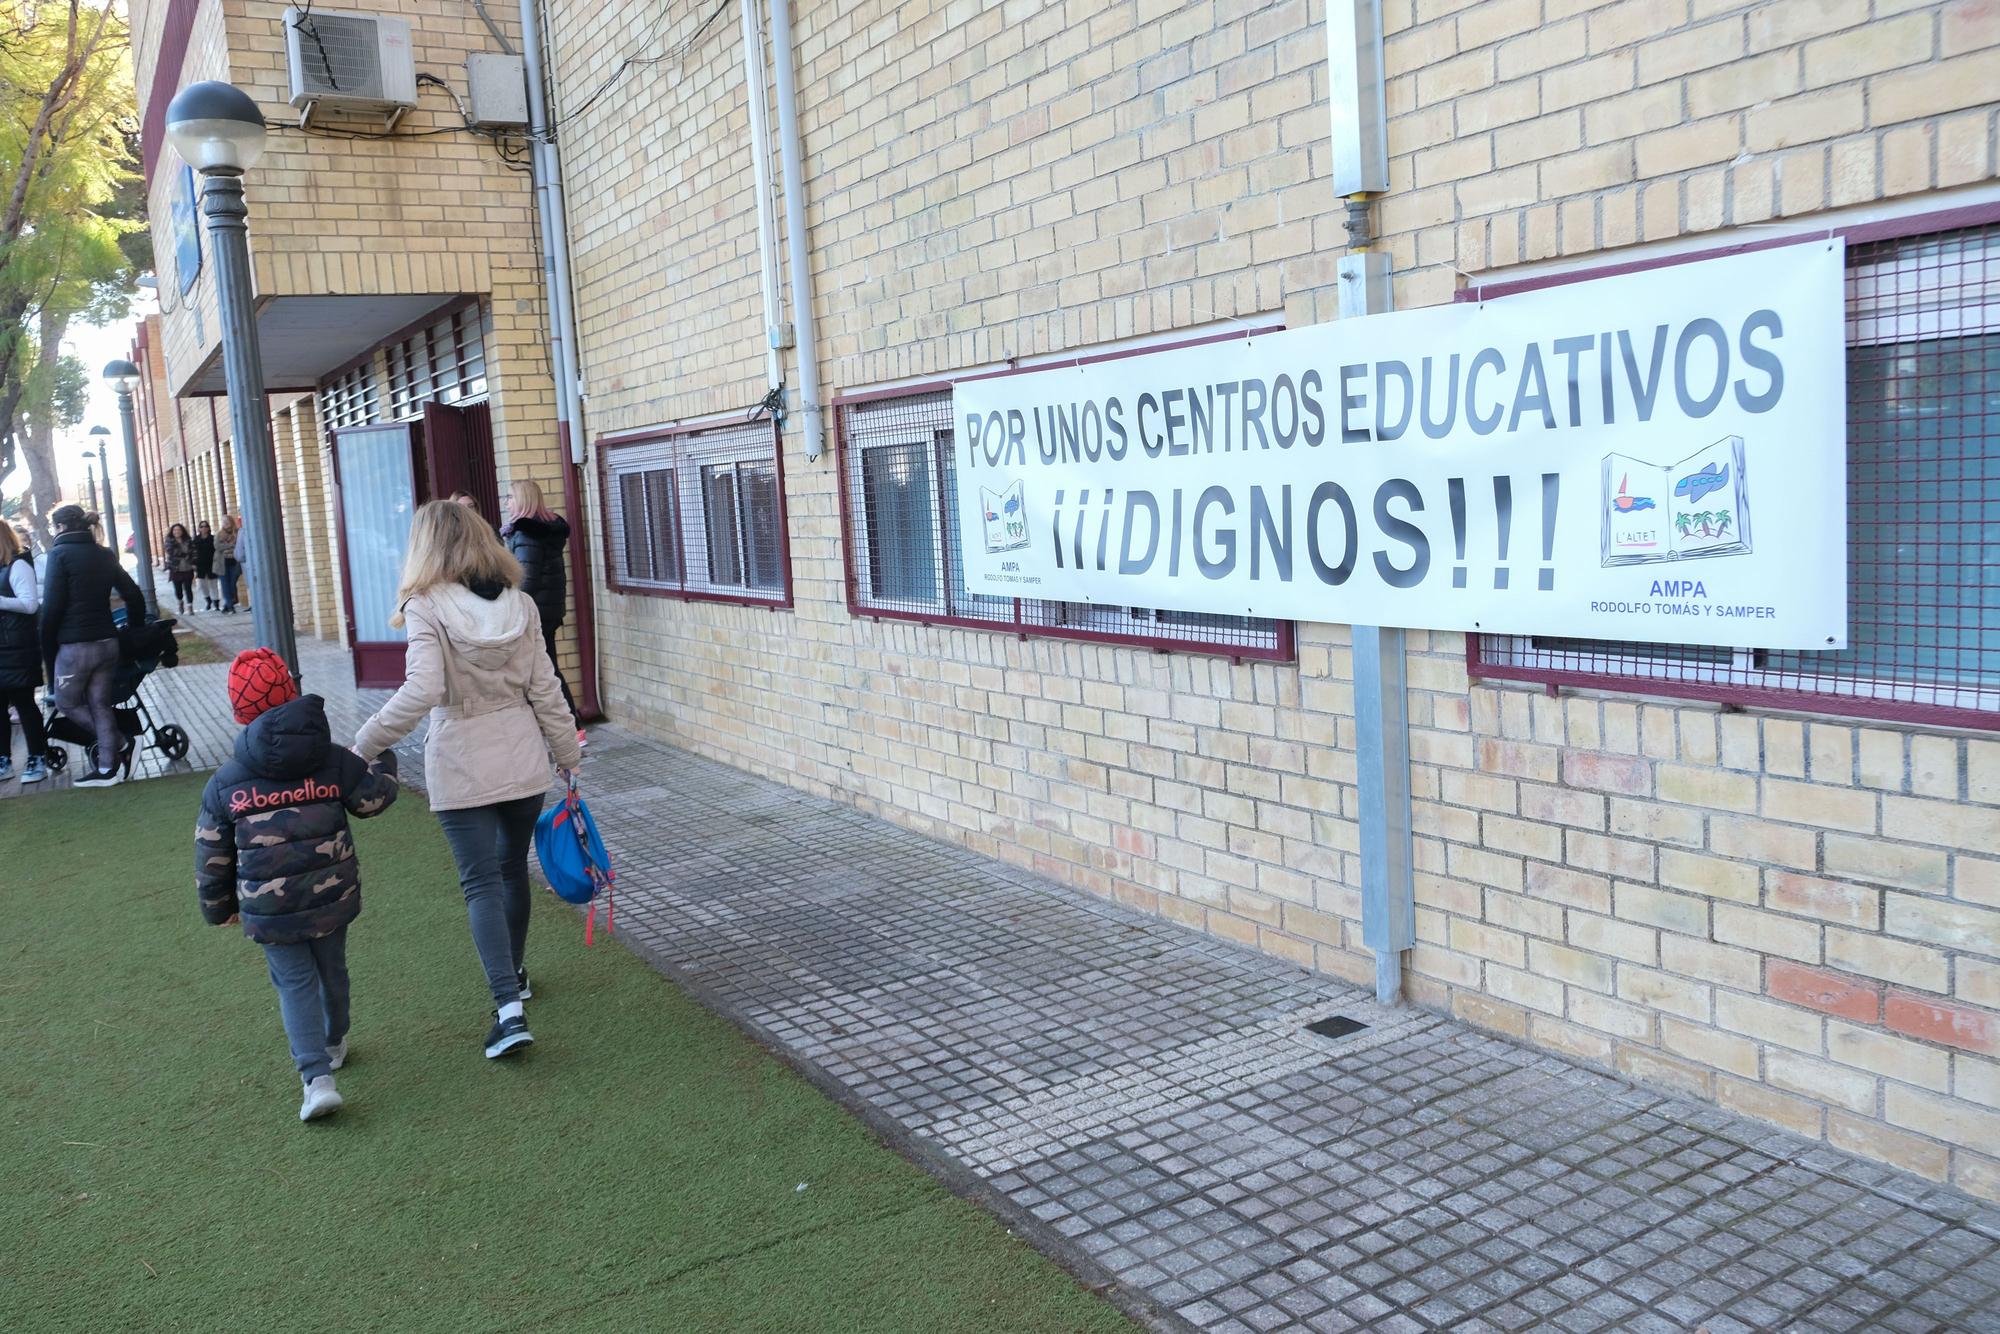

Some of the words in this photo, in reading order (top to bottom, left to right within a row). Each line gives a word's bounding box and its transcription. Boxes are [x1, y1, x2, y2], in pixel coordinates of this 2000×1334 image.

[966, 409, 1026, 468] POR
[1033, 396, 1128, 466] UNOS
[1137, 369, 1325, 459] CENTROS
[1340, 309, 1784, 444] EDUCATIVOS
[1616, 530, 1656, 544] L'ALTET
[1001, 561, 1021, 572] AMPA
[1023, 576, 1042, 584] SAMPER
[1650, 580, 1707, 598] AMPA
[1591, 602, 1651, 613] RODOLFO
[1655, 602, 1699, 616] TOMÁS
[1704, 605, 1712, 616] Y
[1716, 606, 1776, 619] SAMPER
[252, 778, 339, 807] benetton
